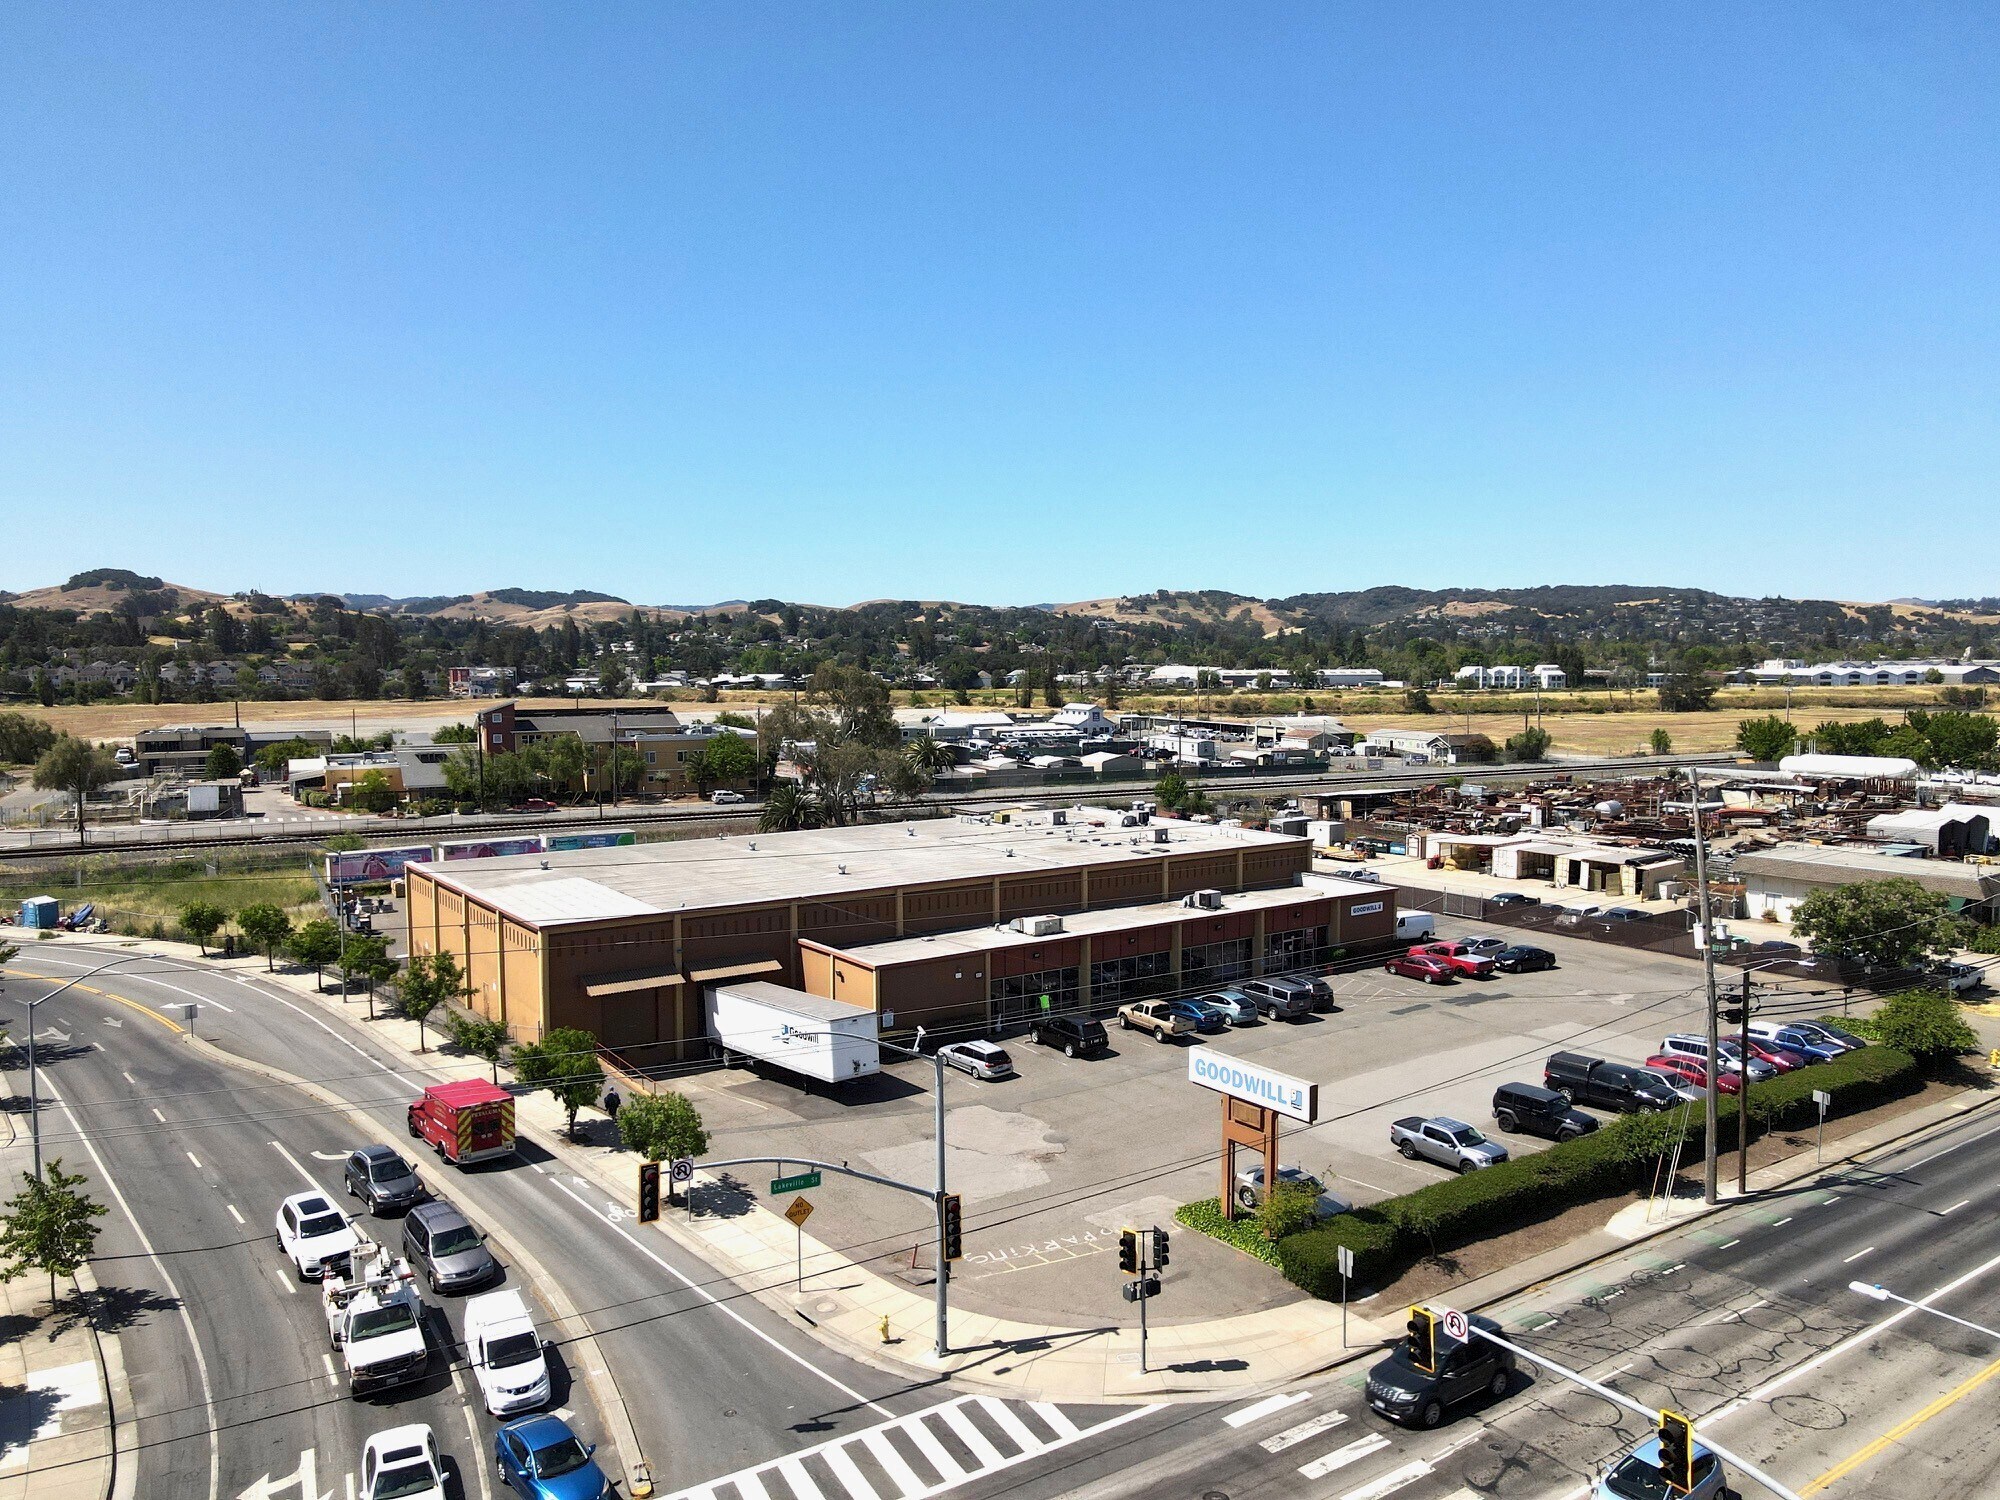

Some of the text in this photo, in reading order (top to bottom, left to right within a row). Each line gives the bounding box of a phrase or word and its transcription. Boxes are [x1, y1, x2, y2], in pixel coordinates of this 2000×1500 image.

[1353, 905, 1377, 914] GOODWILL
[1195, 1058, 1287, 1105] GOODWILL
[773, 1176, 818, 1190] Lakeville St
[795, 1201, 804, 1209] NO
[789, 1208, 811, 1218] OUTLET
